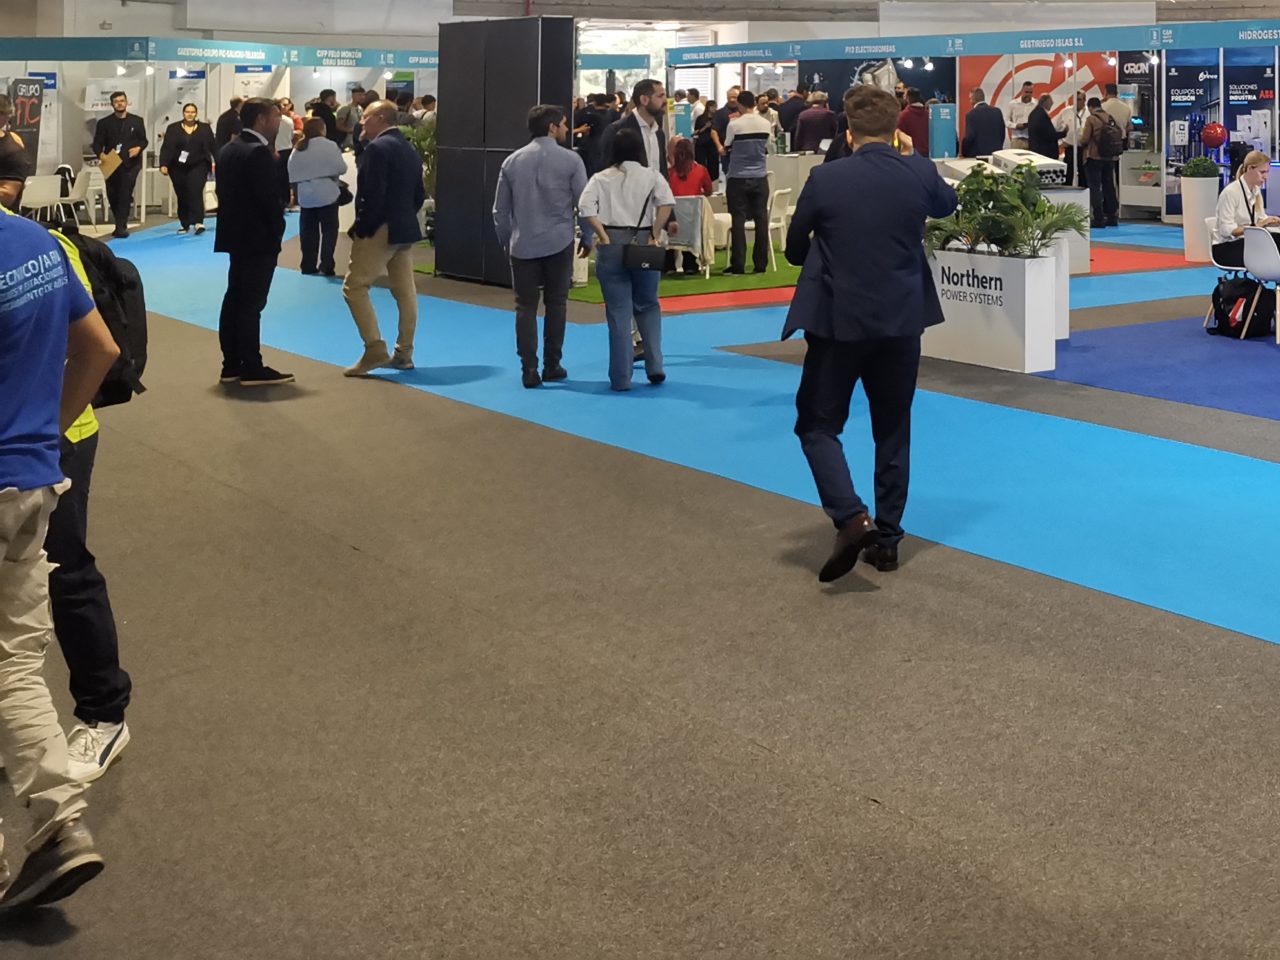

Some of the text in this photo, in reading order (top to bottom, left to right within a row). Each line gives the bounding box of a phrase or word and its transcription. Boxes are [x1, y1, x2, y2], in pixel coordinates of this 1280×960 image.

[1055, 38, 1073, 47] ISLAS
[17, 84, 40, 96] GRUPO
[1259, 90, 1274, 99] ABB
[941, 266, 1003, 291] Northern
[941, 289, 1003, 307] POWER SYSTEMS
